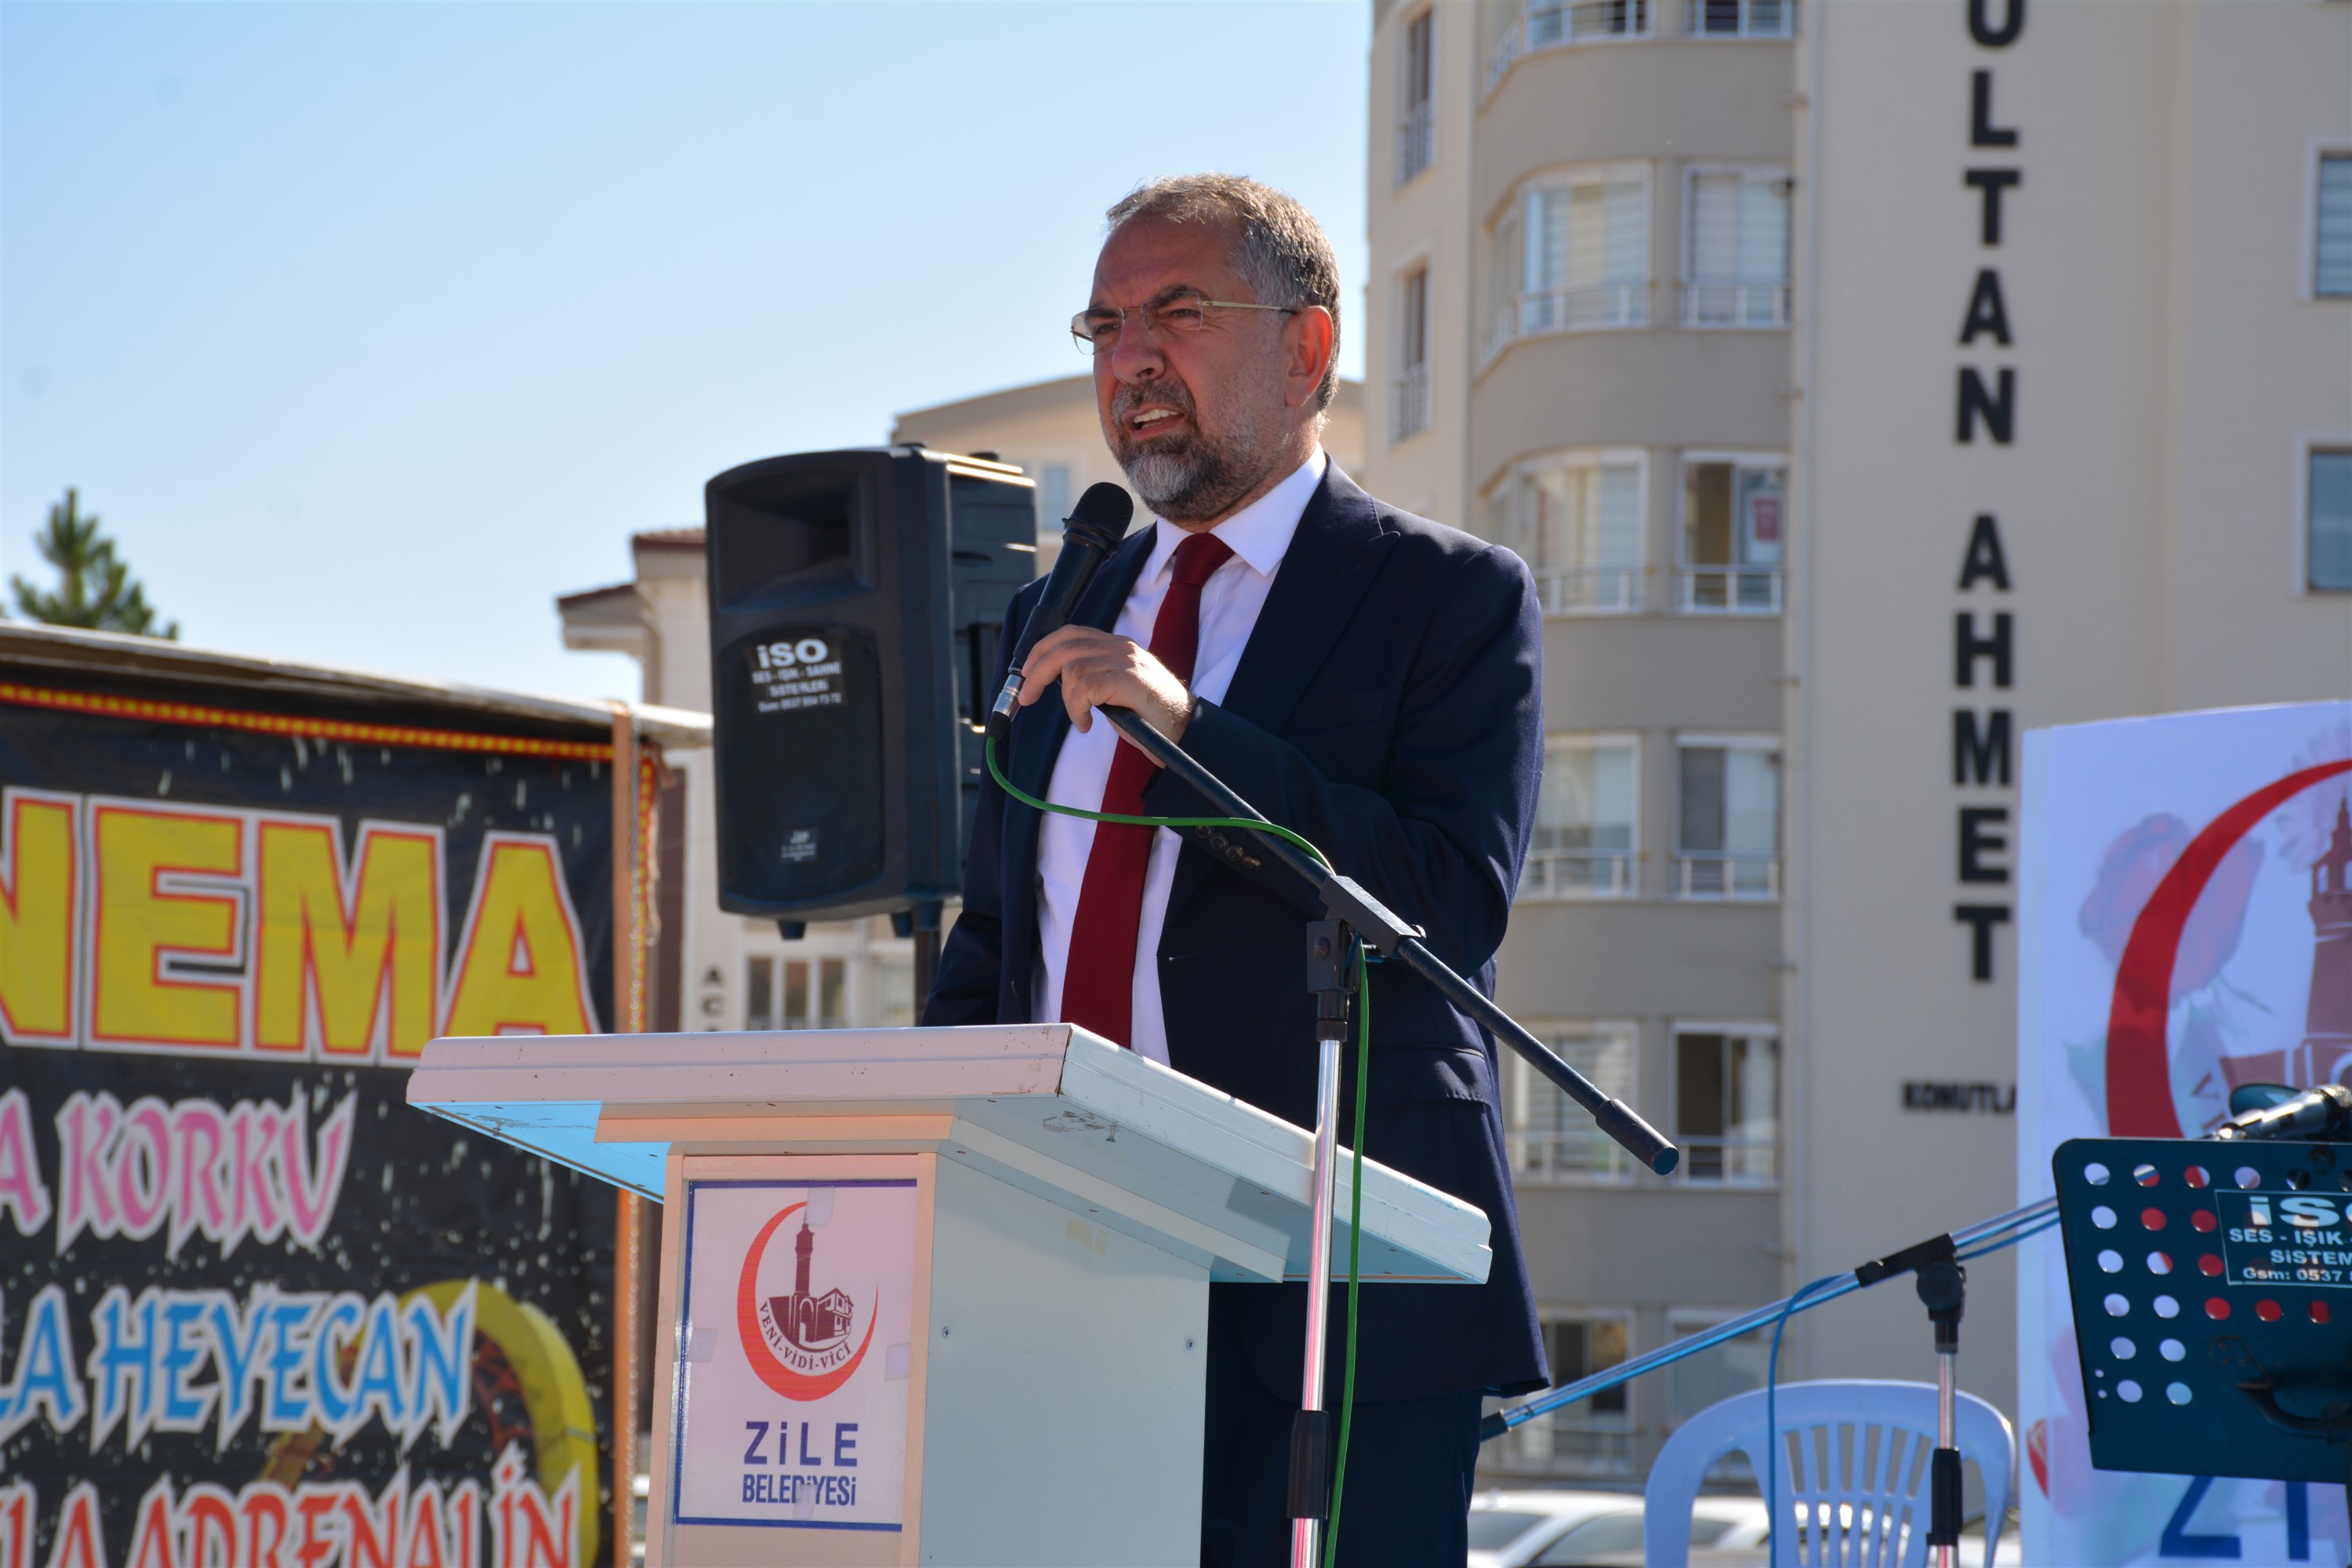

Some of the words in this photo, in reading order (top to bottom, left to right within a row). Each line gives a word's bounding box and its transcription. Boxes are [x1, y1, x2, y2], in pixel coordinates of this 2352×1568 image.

[757, 638, 829, 669] iSO
[1953, 514, 2014, 984] AHMET
[56, 1091, 358, 1258] KORKU
[2229, 1228, 2274, 1243] SES
[2294, 1230, 2343, 1248] IŞIK
[2242, 1267, 2291, 1280] Gsm:
[2296, 1269, 2343, 1282] 0537
[87, 1277, 478, 1454] HEYECAN
